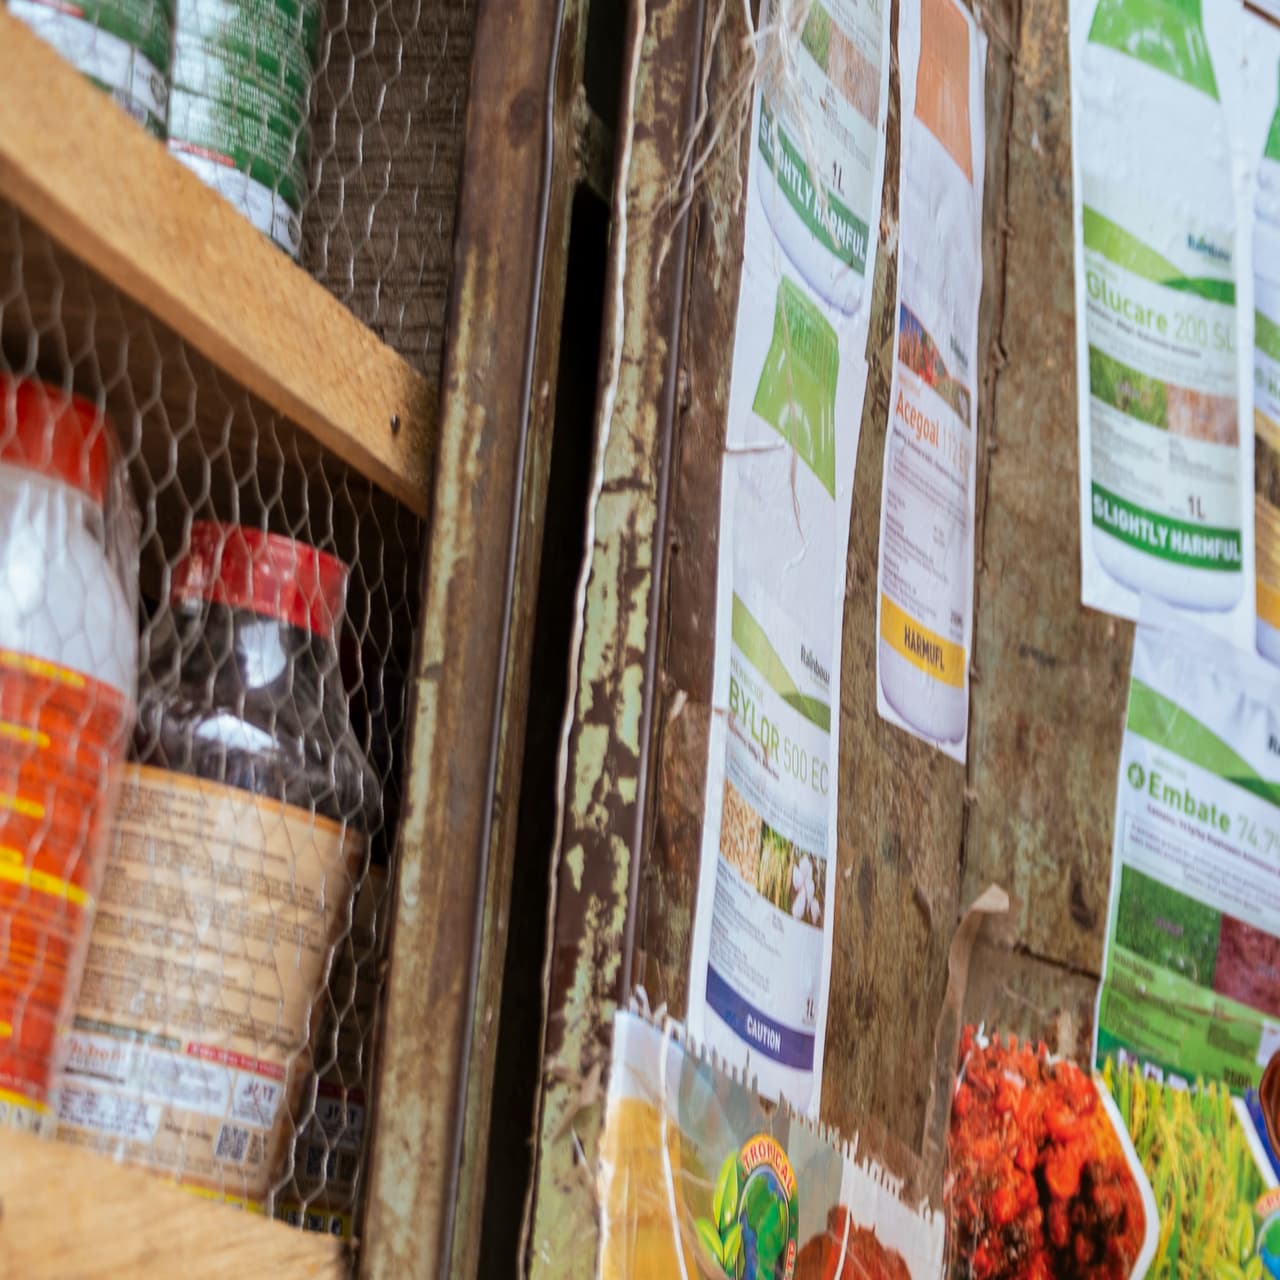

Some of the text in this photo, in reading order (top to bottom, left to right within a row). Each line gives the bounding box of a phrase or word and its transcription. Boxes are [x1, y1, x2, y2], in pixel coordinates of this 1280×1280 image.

[1086, 271, 1168, 335] Glucare
[895, 389, 939, 448] Acegoal
[1094, 495, 1169, 550] SLIGHTLY
[1170, 531, 1242, 562] HARMFUL
[729, 675, 779, 763] BYLOR
[784, 736, 807, 783] 500
[811, 756, 829, 797] EC
[1148, 771, 1232, 833] Embate
[746, 1013, 781, 1053] CAUTION
[743, 1141, 794, 1199] TROPICAL
